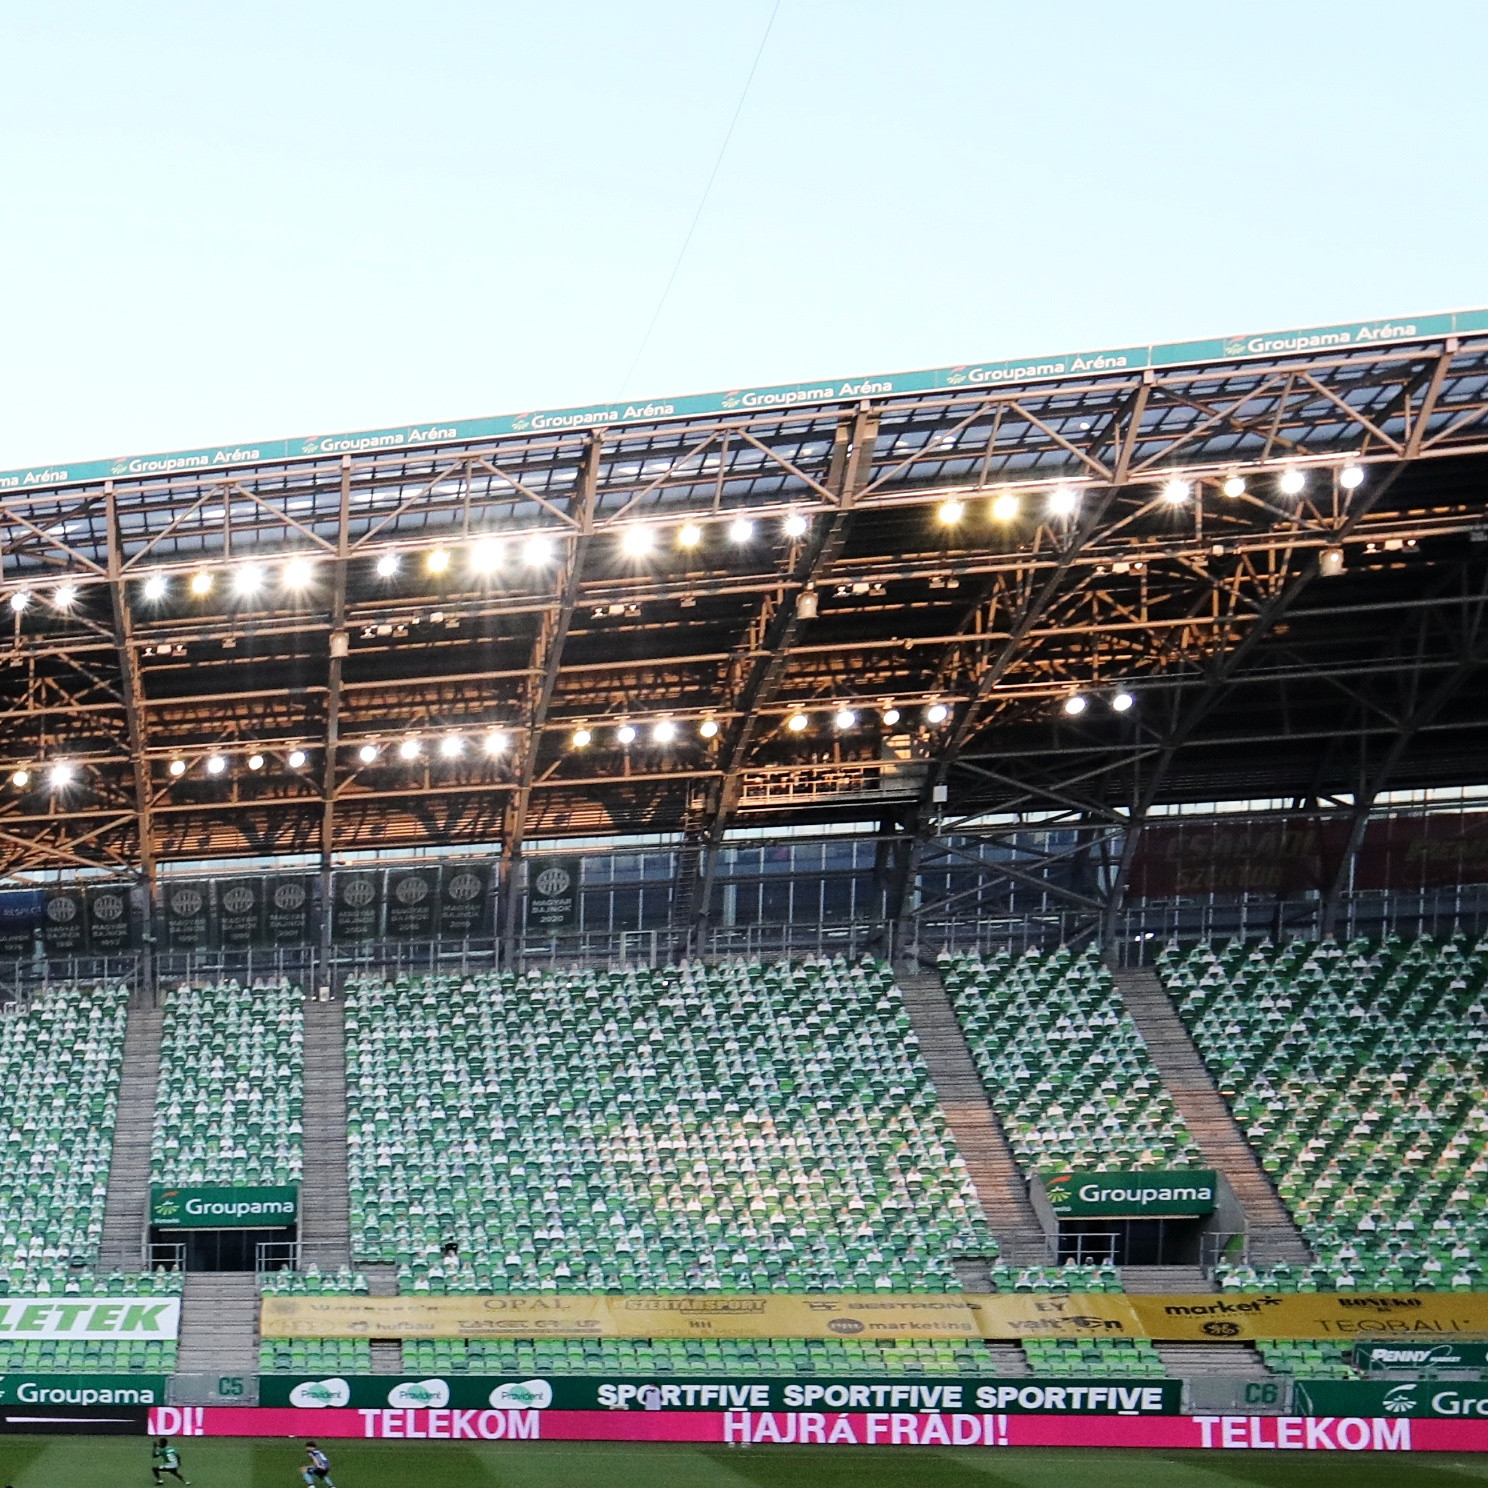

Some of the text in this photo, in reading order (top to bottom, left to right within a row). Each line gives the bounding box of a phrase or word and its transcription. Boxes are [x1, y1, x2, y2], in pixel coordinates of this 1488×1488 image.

[1248, 321, 1415, 354] Groupama Aréna
[969, 353, 1126, 384] Groupama Aréna
[742, 378, 892, 407] Groupama Aréna
[531, 400, 674, 429] Groupama Aréna
[321, 425, 456, 453] Groupama Aréna
[129, 446, 259, 474] Groupama Aréna
[23, 467, 68, 484] Aréna
[1079, 1184, 1211, 1205] Groupama
[185, 1199, 294, 1217] Groupama
[869, 1322, 972, 1331] marketing
[1371, 1348, 1431, 1362] PENNY
[17, 1383, 154, 1406] Groupama
[218, 1377, 244, 1395] C5
[301, 1389, 342, 1400] Provident
[399, 1389, 443, 1401] Provident
[501, 1390, 545, 1401] Provident
[597, 1384, 769, 1408] SPORTFIVE
[783, 1385, 962, 1409] SPORTFIVE
[1245, 1383, 1279, 1404] C6
[976, 1386, 1163, 1411] SPORTFIVE
[359, 1409, 540, 1439] TELEKOM
[724, 1411, 1009, 1446] HAJRÁ FRADI!
[1193, 1416, 1412, 1451] TELEKOM
